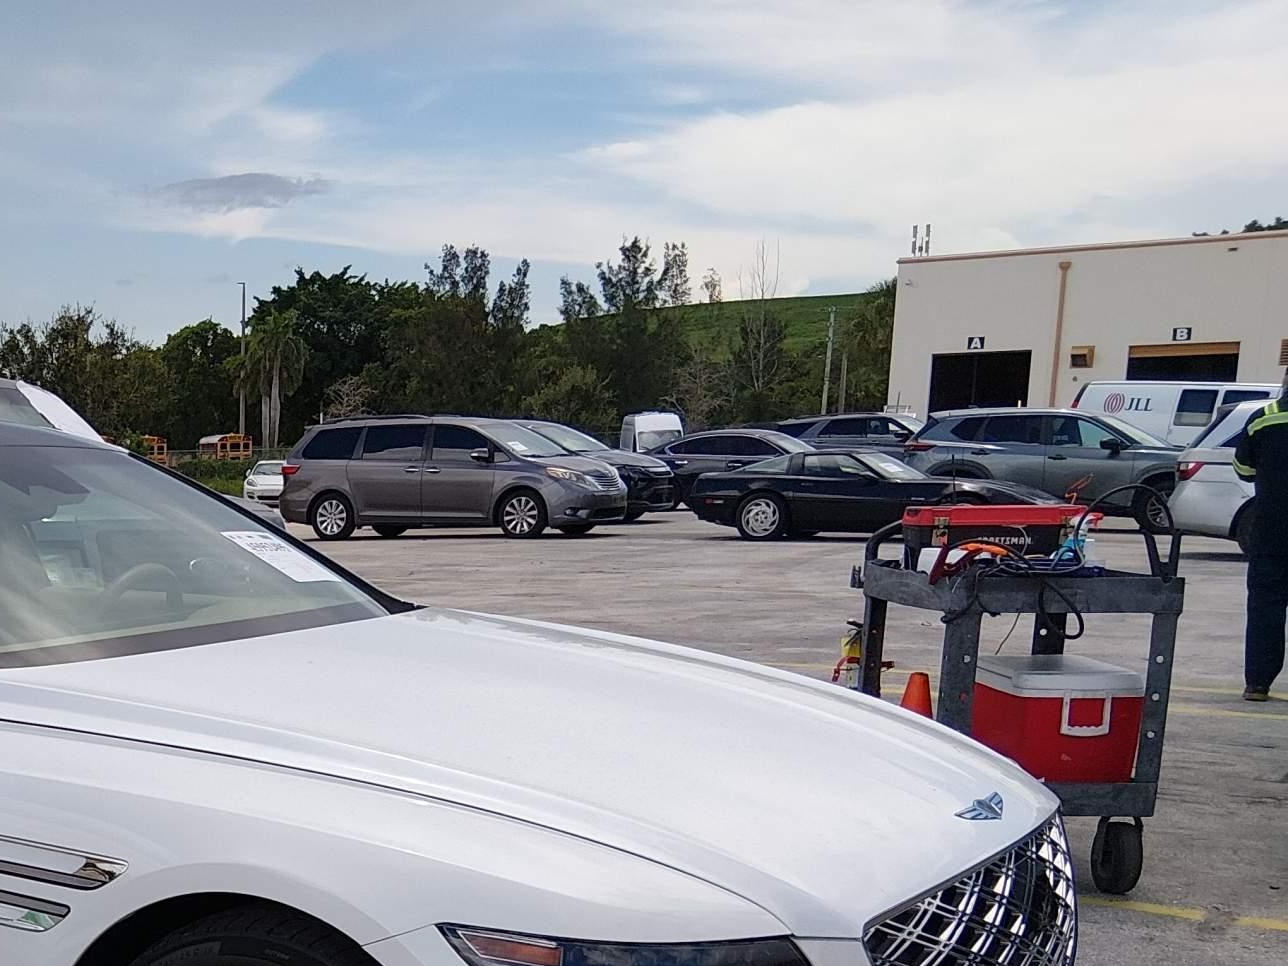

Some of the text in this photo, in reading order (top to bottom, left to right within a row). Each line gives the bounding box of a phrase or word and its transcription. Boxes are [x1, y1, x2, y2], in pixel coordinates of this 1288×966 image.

[1176, 328, 1188, 340] B
[970, 337, 982, 349] A
[1124, 397, 1152, 411] JLL
